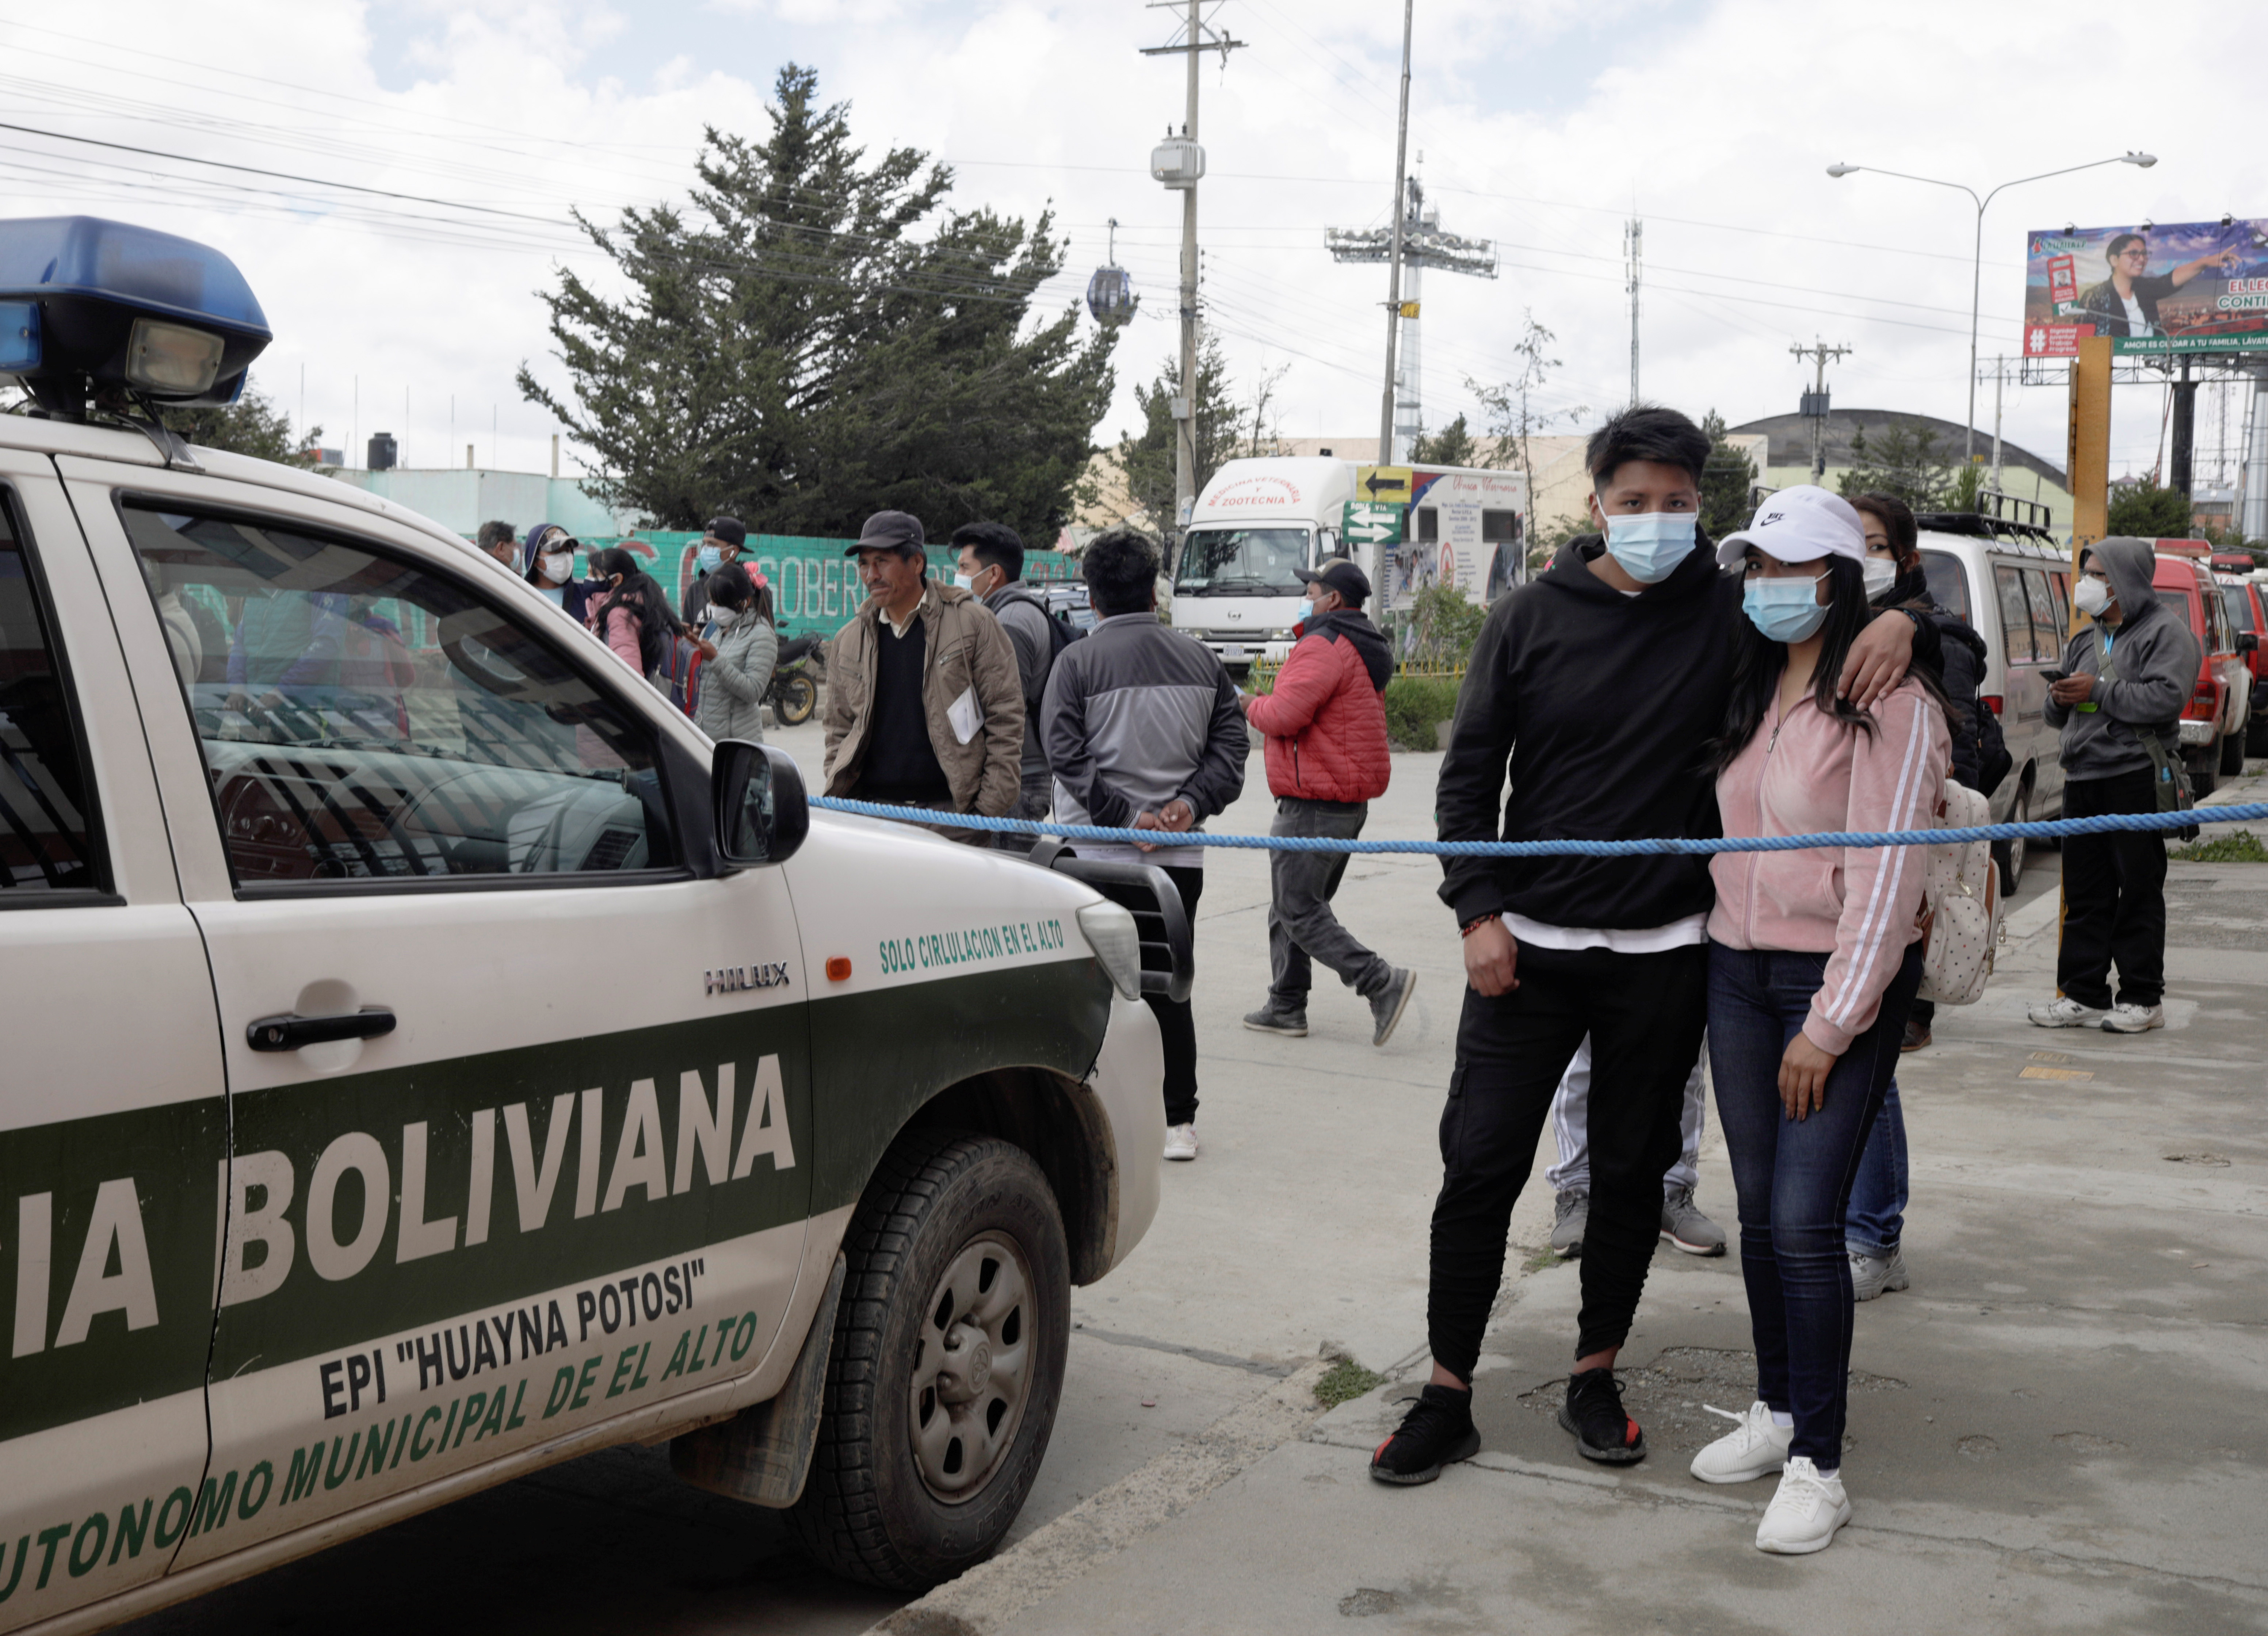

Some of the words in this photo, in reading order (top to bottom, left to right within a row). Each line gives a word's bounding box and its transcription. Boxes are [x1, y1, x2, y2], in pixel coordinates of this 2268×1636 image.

[2219, 295, 2268, 308] CONTI
[2230, 280, 2245, 292] EL
[2123, 341, 2147, 349] AMOR
[2148, 340, 2157, 348] ES
[2159, 339, 2188, 348] CUDAR
[2208, 338, 2240, 347] FAMILIA,
[1207, 479, 1253, 507] MEDICINA
[1222, 496, 1285, 507] ZOOTECNIA
[757, 556, 867, 619] GOBER
[879, 937, 915, 975] SOLO
[919, 926, 1003, 968] CIRLULACION
[1001, 923, 1022, 955] EN
[1020, 922, 1038, 953] EL
[1037, 918, 1064, 951] ALTO
[704, 959, 790, 996] HILUX
[0, 1177, 159, 1359] IA
[212, 1053, 796, 1310] BOLIVIANA
[319, 1348, 386, 1420] EPI
[396, 1299, 568, 1390] "HUAYNA
[576, 1258, 705, 1342] POTOSI"
[0, 1459, 274, 1605] UTONOMO
[279, 1379, 528, 1507] MUNICIPAL
[542, 1355, 603, 1421] DE
[605, 1341, 652, 1399] EL
[660, 1310, 758, 1382] ALTO
